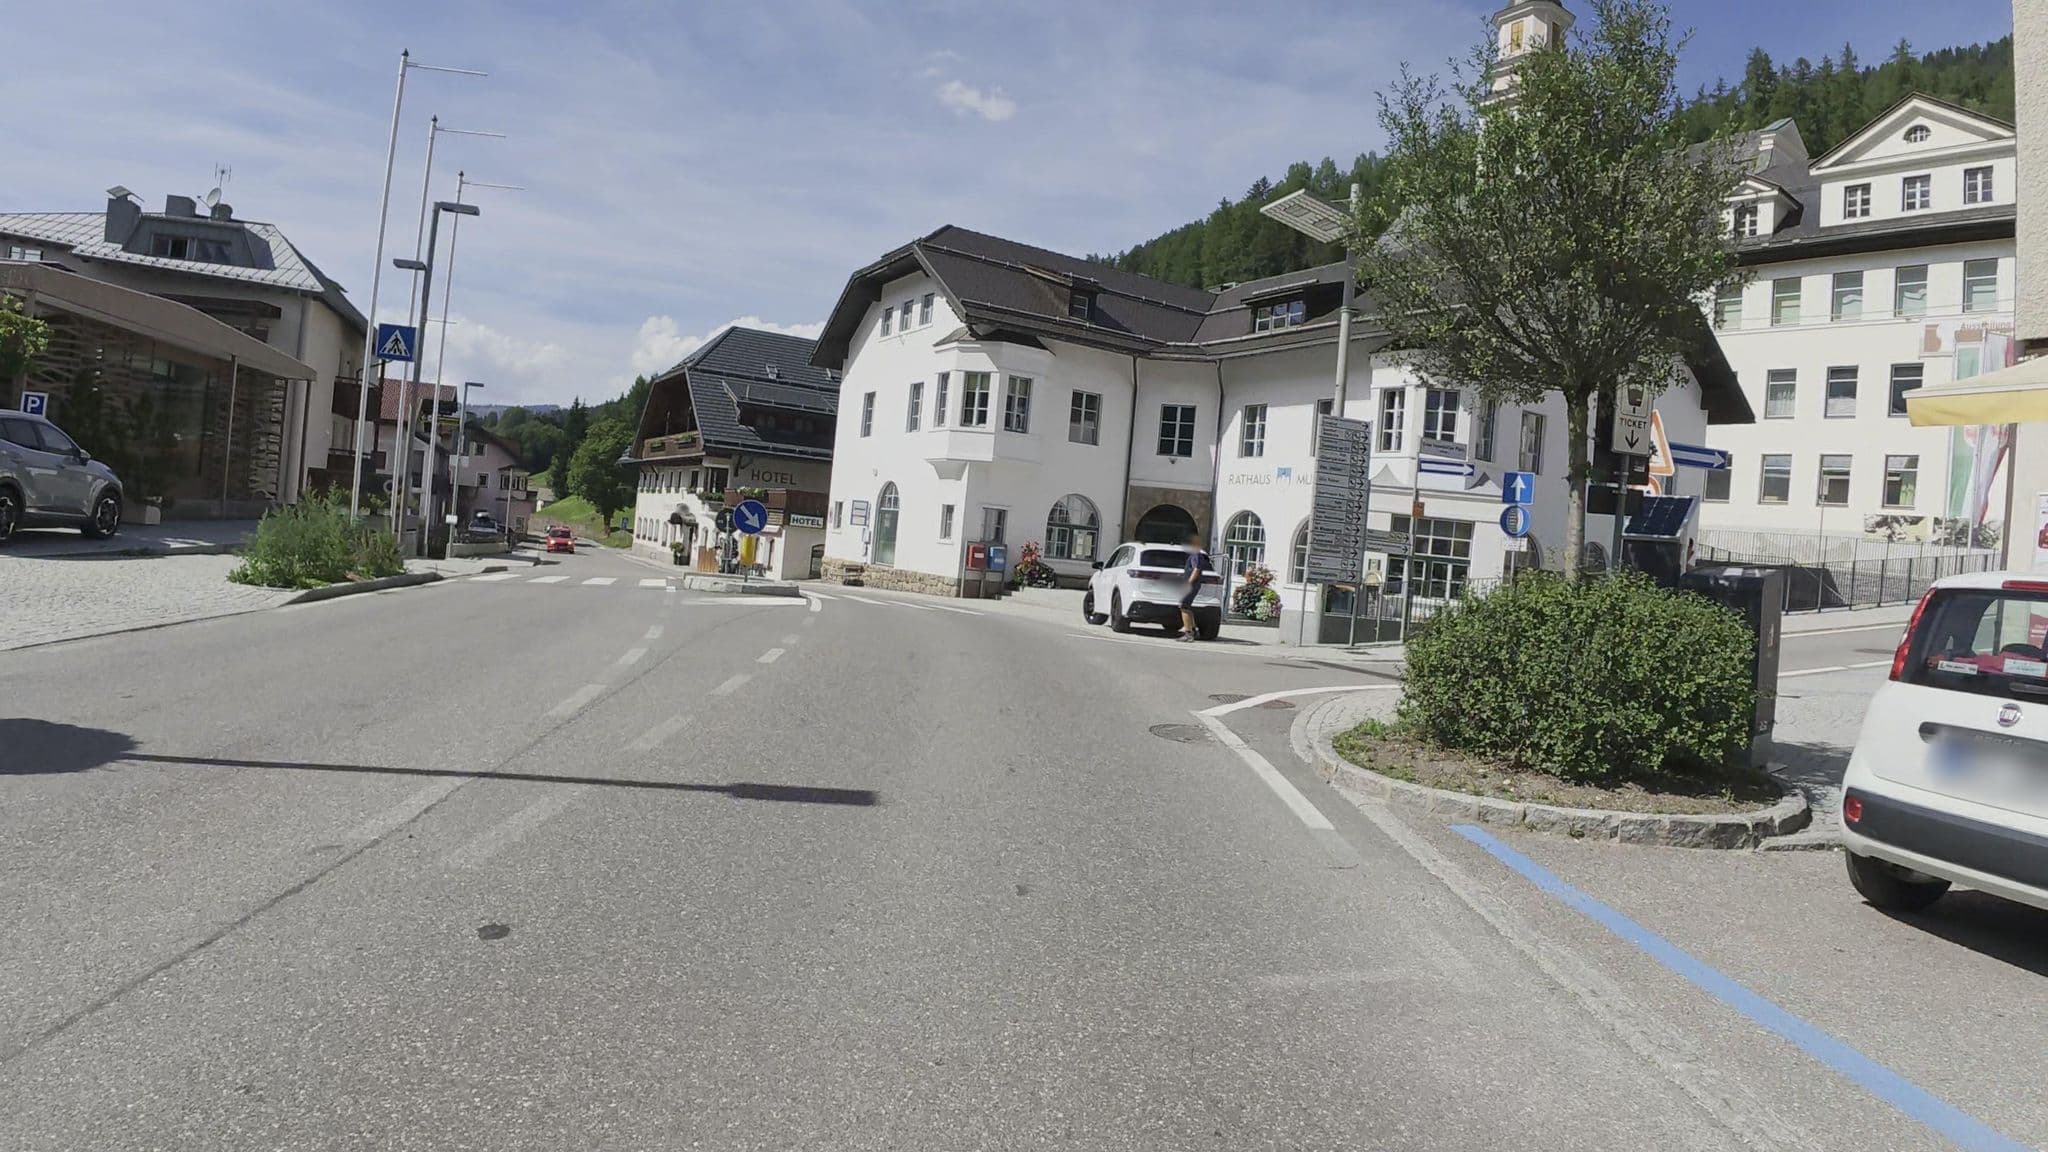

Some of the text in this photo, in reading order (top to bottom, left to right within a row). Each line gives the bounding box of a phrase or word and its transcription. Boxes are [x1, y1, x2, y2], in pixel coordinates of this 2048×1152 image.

[27, 397, 41, 412] P
[1620, 417, 1647, 429] TICKET
[751, 469, 797, 485] HOTEL
[1229, 473, 1271, 485] RATHAUS
[791, 516, 822, 526] HOTEL
